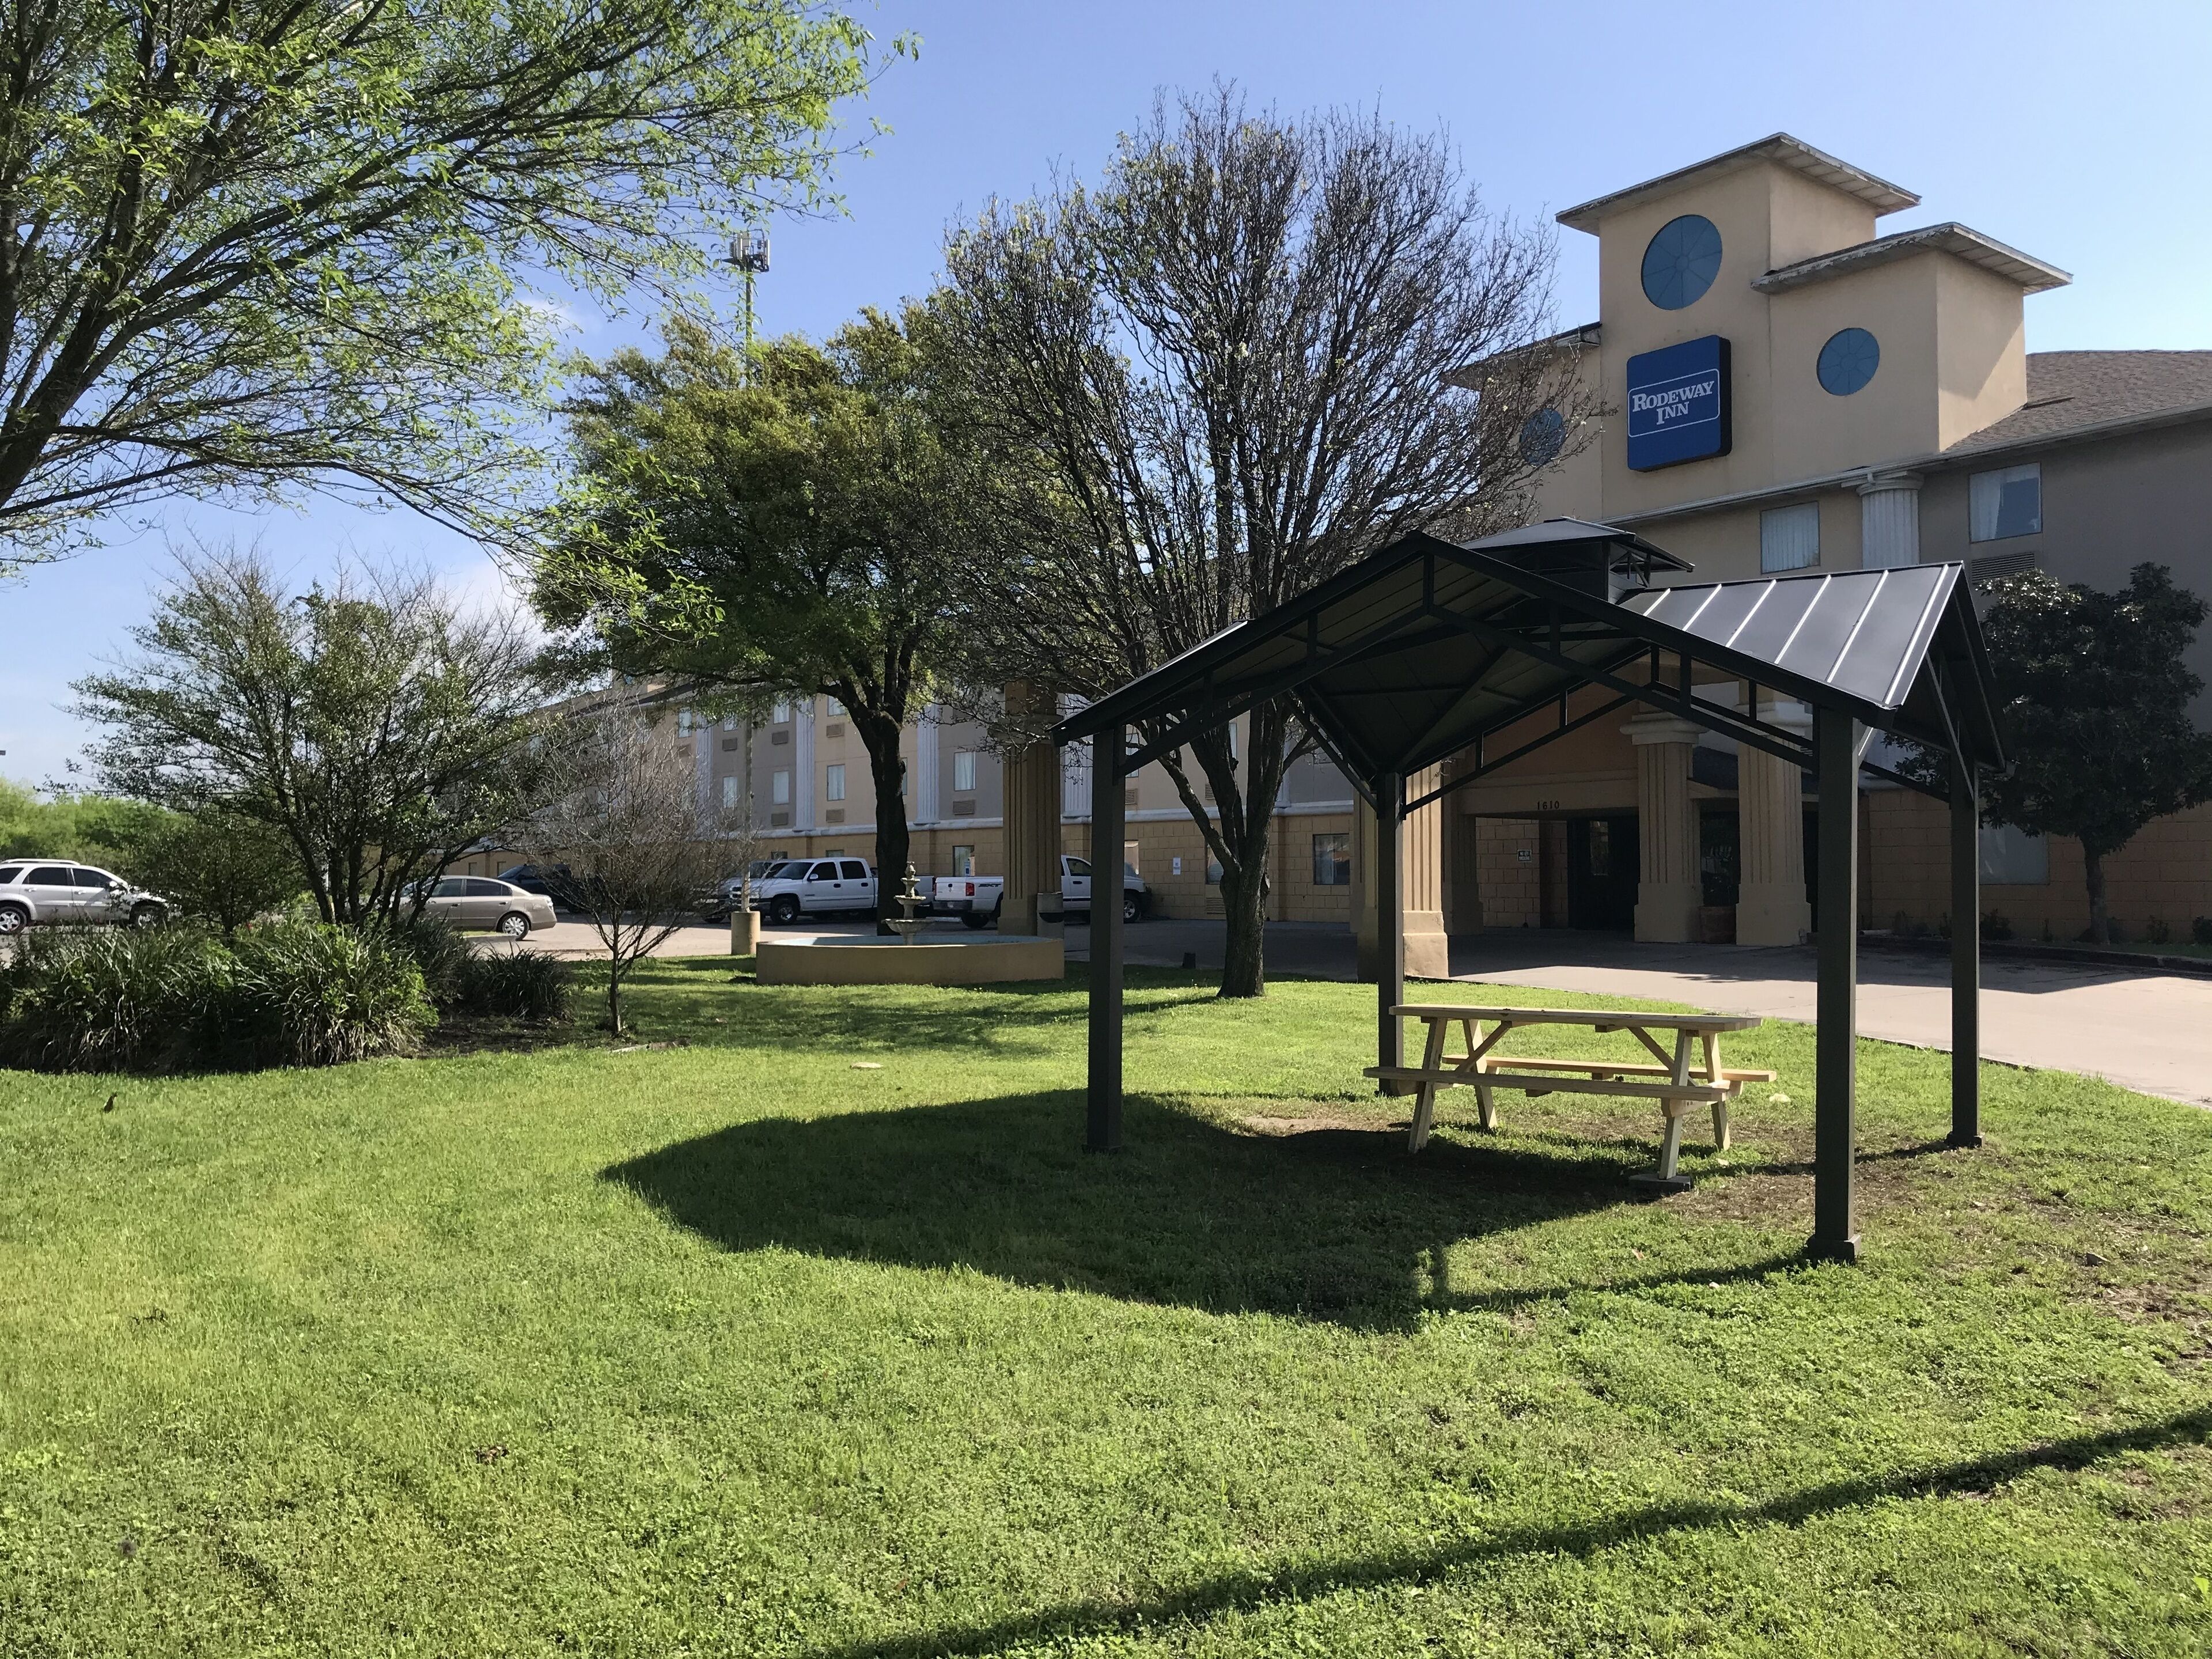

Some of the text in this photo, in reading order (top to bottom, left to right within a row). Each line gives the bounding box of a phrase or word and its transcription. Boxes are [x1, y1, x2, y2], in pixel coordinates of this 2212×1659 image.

[1632, 381, 1714, 412] RODEWAY
[1656, 402, 1690, 425] INN
[1537, 801, 1559, 810] 1610
